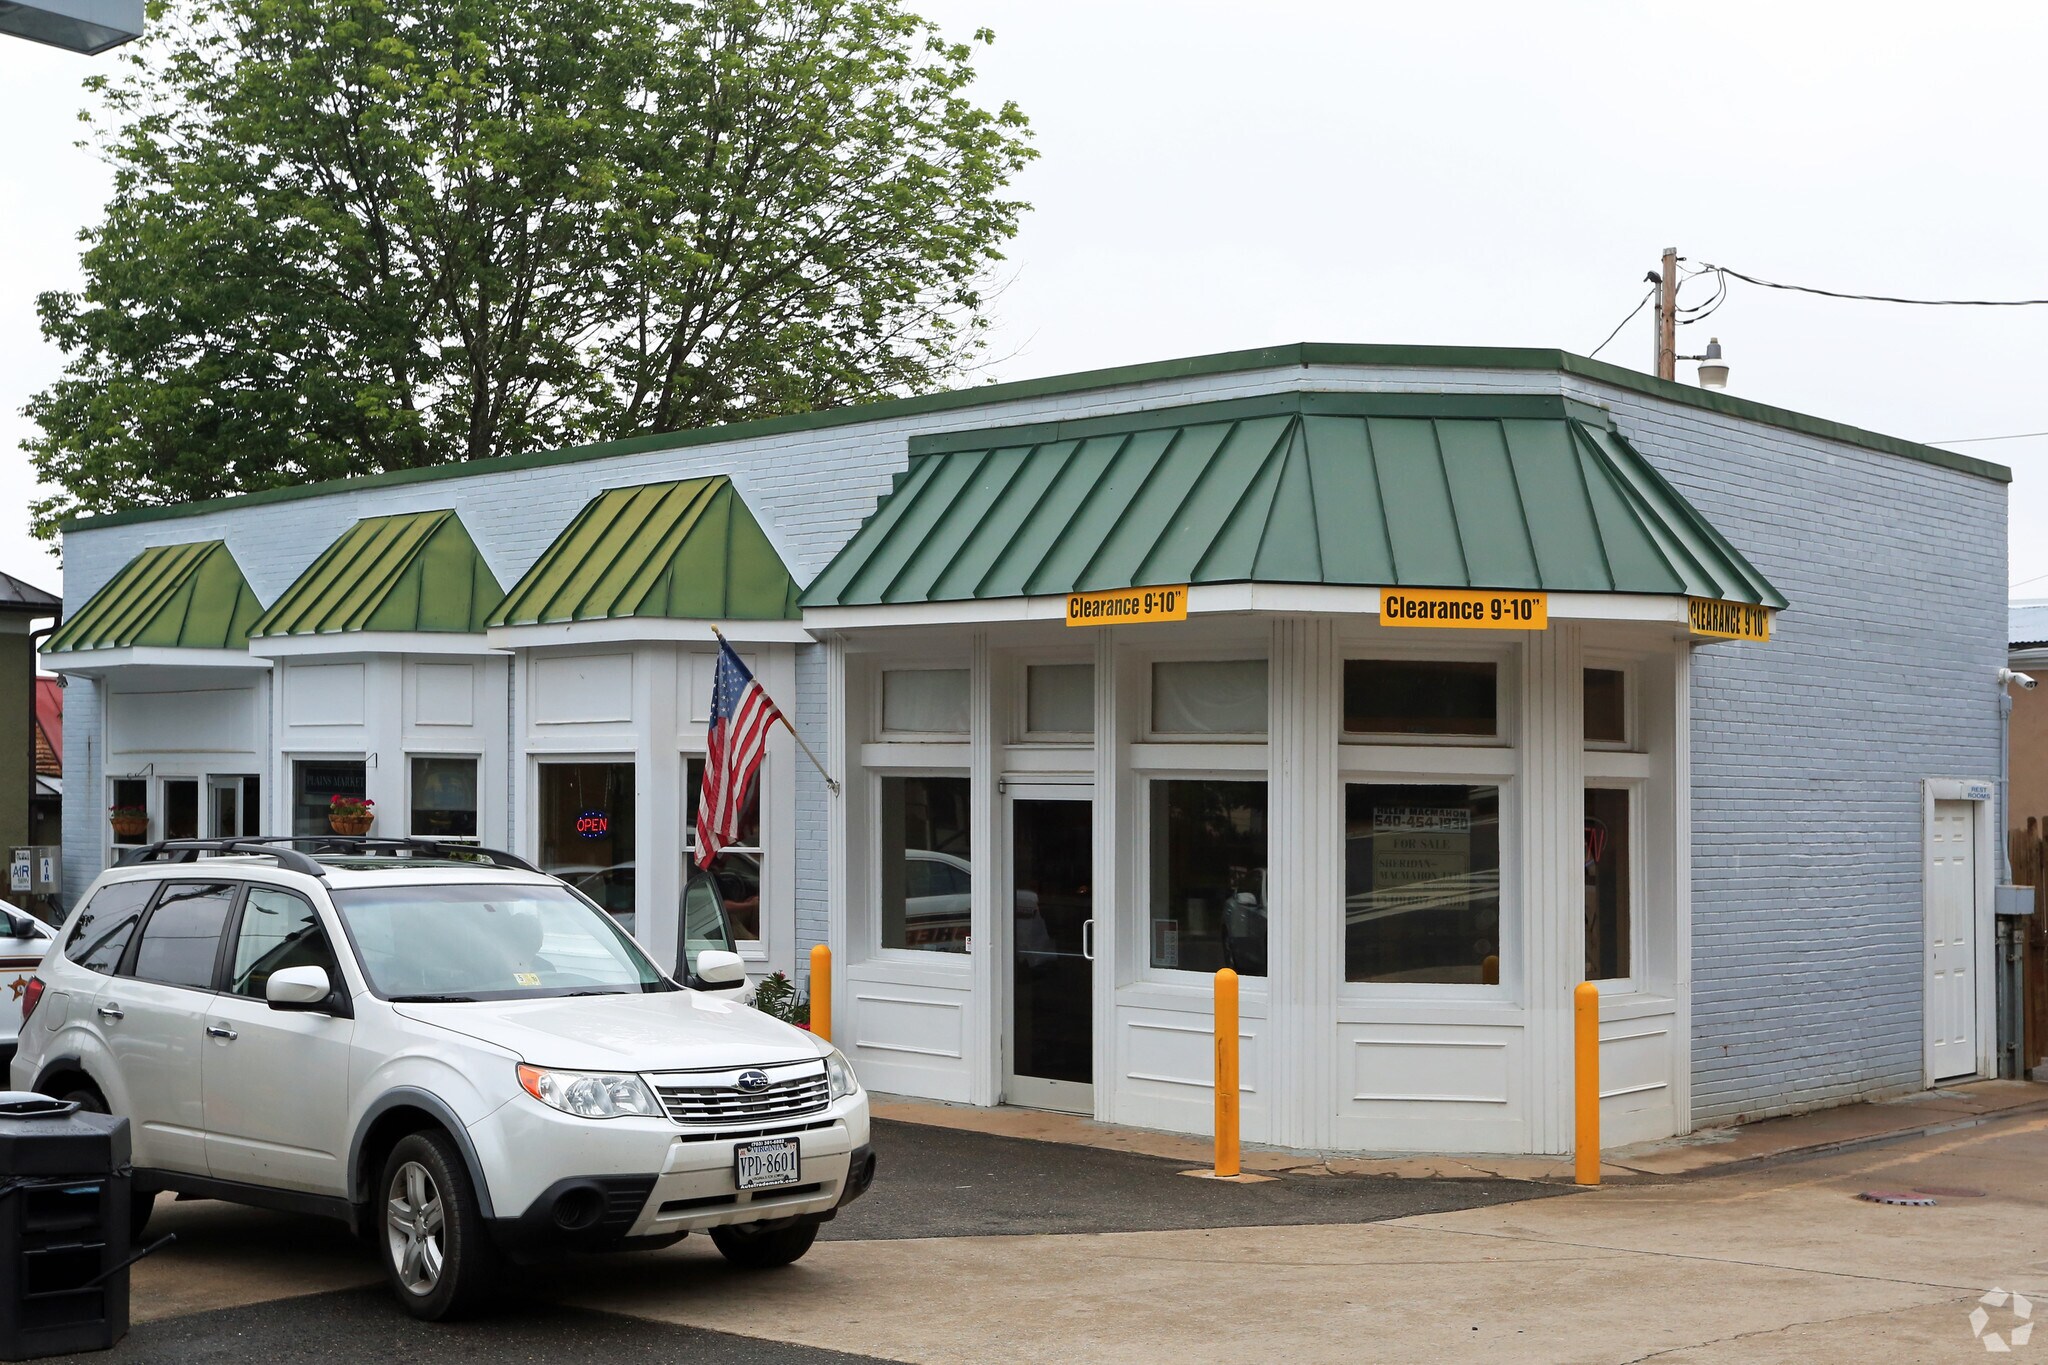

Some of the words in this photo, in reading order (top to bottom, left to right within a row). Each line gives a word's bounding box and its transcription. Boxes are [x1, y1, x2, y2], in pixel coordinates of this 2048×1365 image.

[1070, 597, 1140, 619] Clearance
[1386, 595, 1484, 620] Clearance
[1690, 600, 1741, 634] CLEARANCE
[305, 775, 332, 786] PLAINS
[333, 775, 365, 787] MARKET
[1376, 807, 1405, 815] HELEN
[1409, 808, 1467, 817] MACMAHON
[576, 818, 608, 832] OPEN
[1393, 839, 1416, 849] FOR
[1420, 839, 1450, 850] SALE
[12, 865, 30, 878] AIR
[1379, 870, 1438, 881] MACMAHON
[752, 1144, 783, 1152] VIRGINIA
[740, 1151, 795, 1177] VPD-8601
